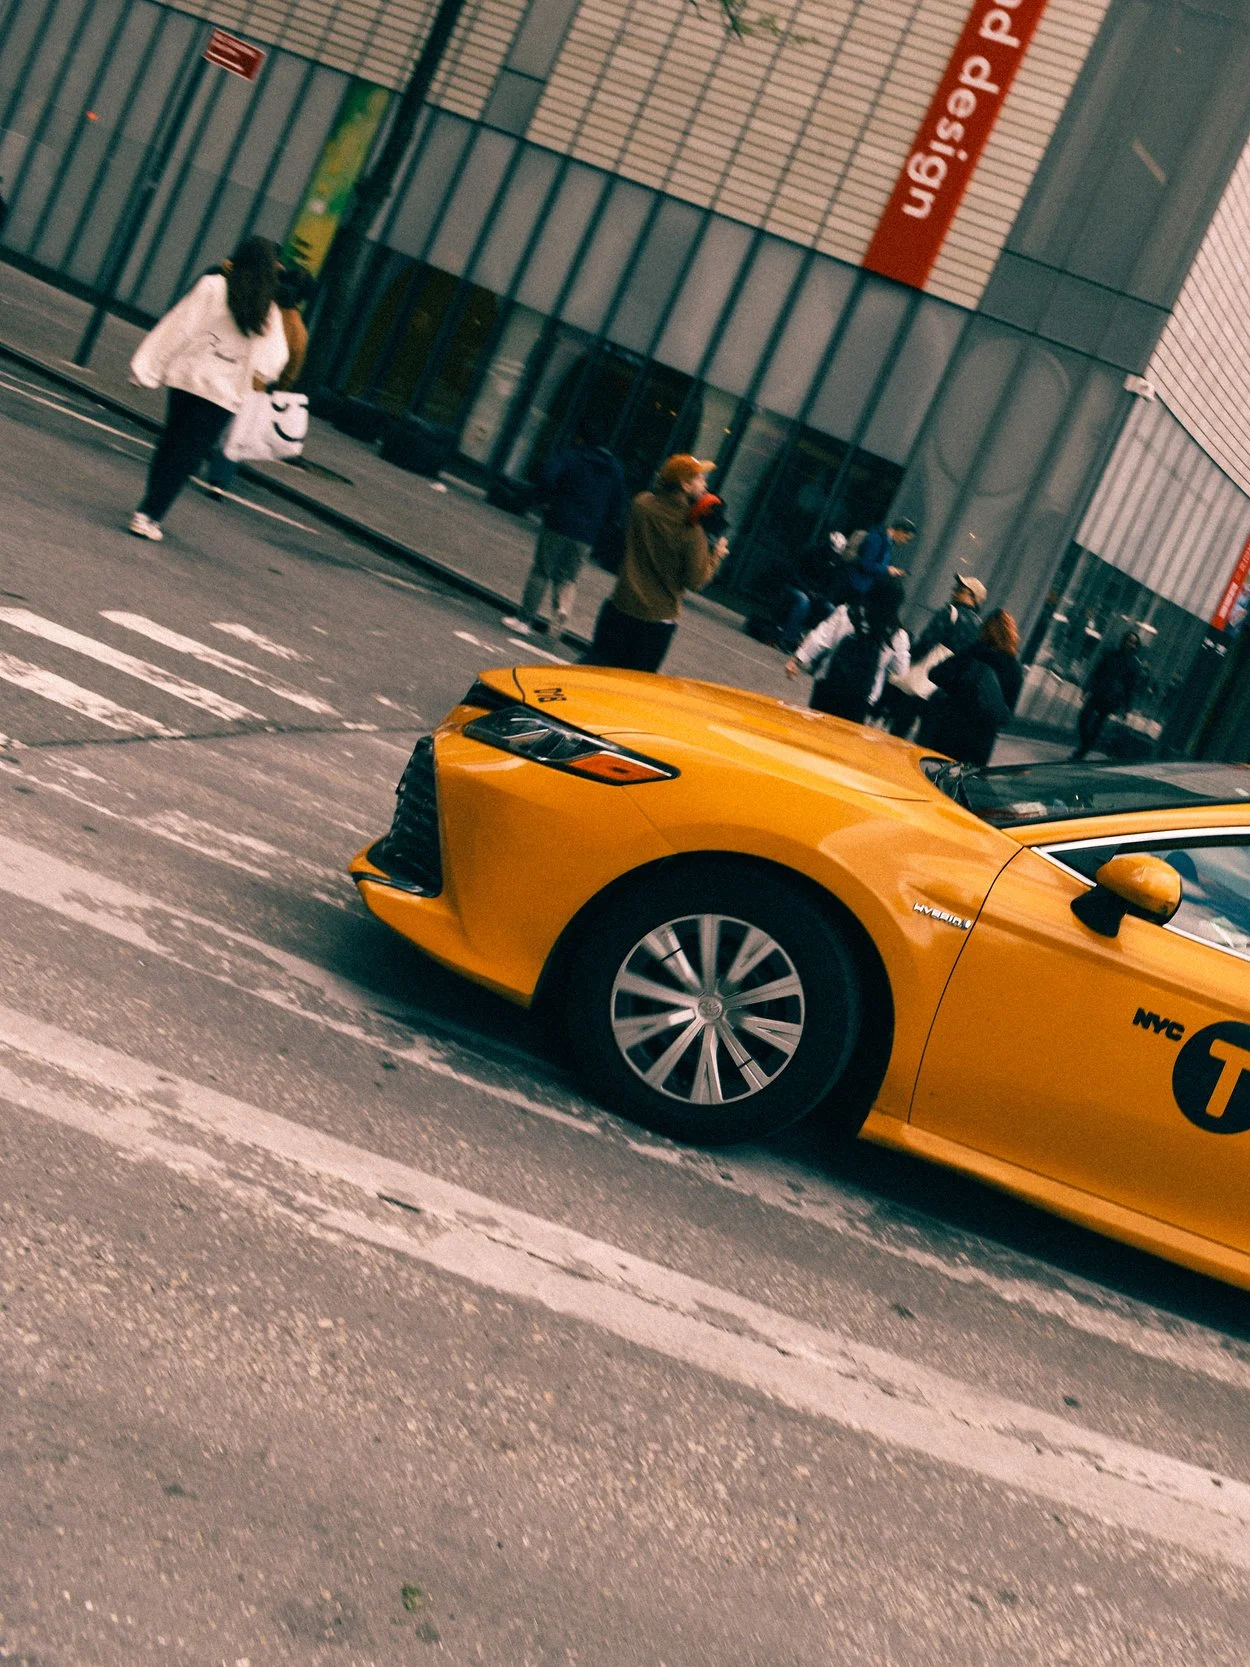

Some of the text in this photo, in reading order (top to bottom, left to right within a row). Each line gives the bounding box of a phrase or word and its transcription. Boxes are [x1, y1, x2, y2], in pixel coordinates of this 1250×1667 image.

[901, 55, 1000, 219] design
[913, 902, 962, 927] HYBRID
[1132, 1007, 1186, 1042] NYC
